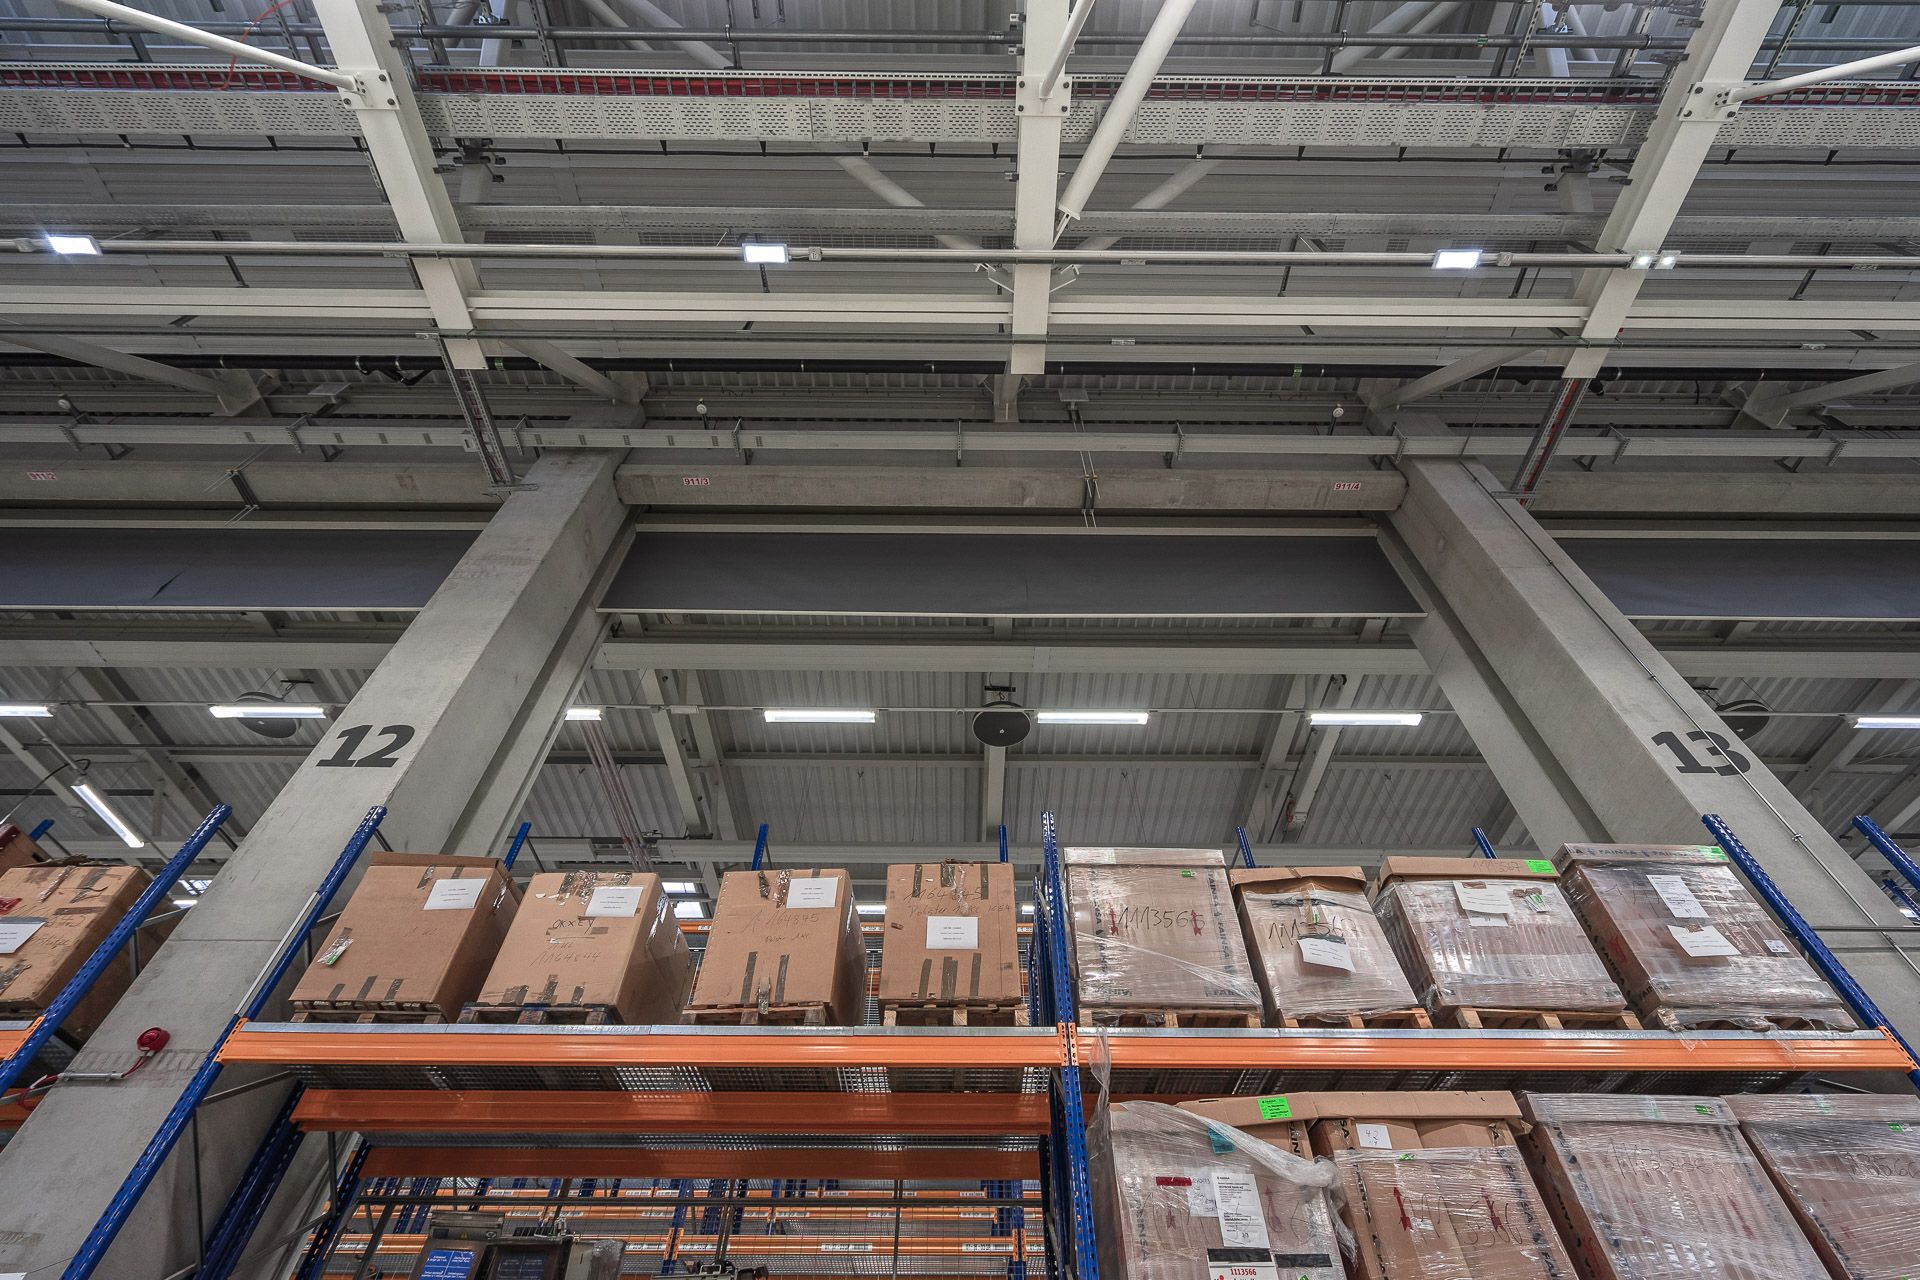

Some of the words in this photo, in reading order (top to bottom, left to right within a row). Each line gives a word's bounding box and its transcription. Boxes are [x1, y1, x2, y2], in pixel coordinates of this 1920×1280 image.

[315, 724, 416, 768] 12
[1651, 730, 1751, 776] 13
[1230, 1268, 1257, 1276] 1113566
